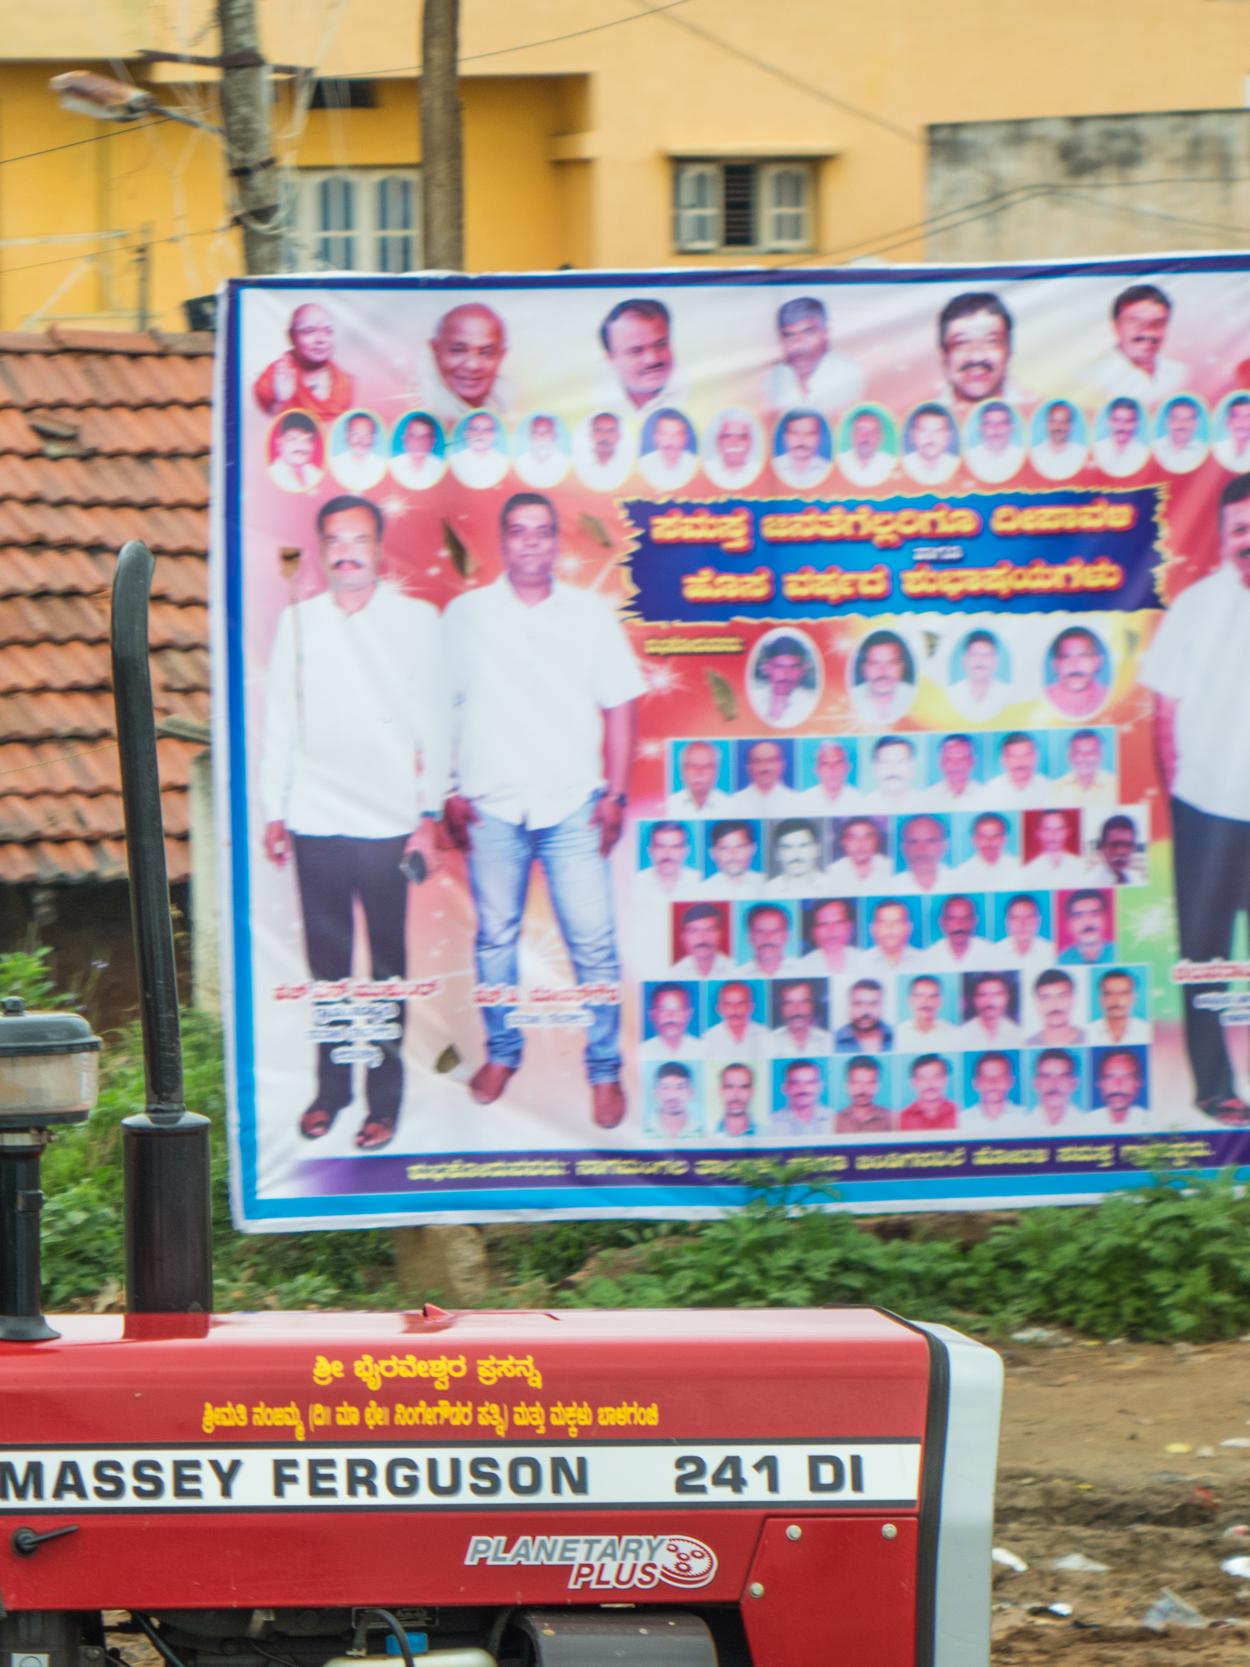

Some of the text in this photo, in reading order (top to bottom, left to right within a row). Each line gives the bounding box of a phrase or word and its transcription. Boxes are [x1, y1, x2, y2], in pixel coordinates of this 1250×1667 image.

[681, 566, 775, 603] ಹೊಸ
[312, 1354, 543, 1391] ಶ್ರೀ ಭೈರವೇಶ್ವರ ಪ್ರಸನ್ನ
[201, 1401, 248, 1434] ಶ್ರೀಮತಿ
[251, 1401, 306, 1442] ನಂಜಮ್ಮ
[512, 1401, 546, 1435] ಮತ್ತು
[549, 1401, 593, 1438] ಮಕ್ಕಳು
[272, 1456, 589, 1499] FERGUSON
[674, 1454, 780, 1495] 241
[807, 1453, 864, 1494] DI
[465, 1536, 667, 1566] PLANETARY
[569, 1562, 661, 1589] PLUS
